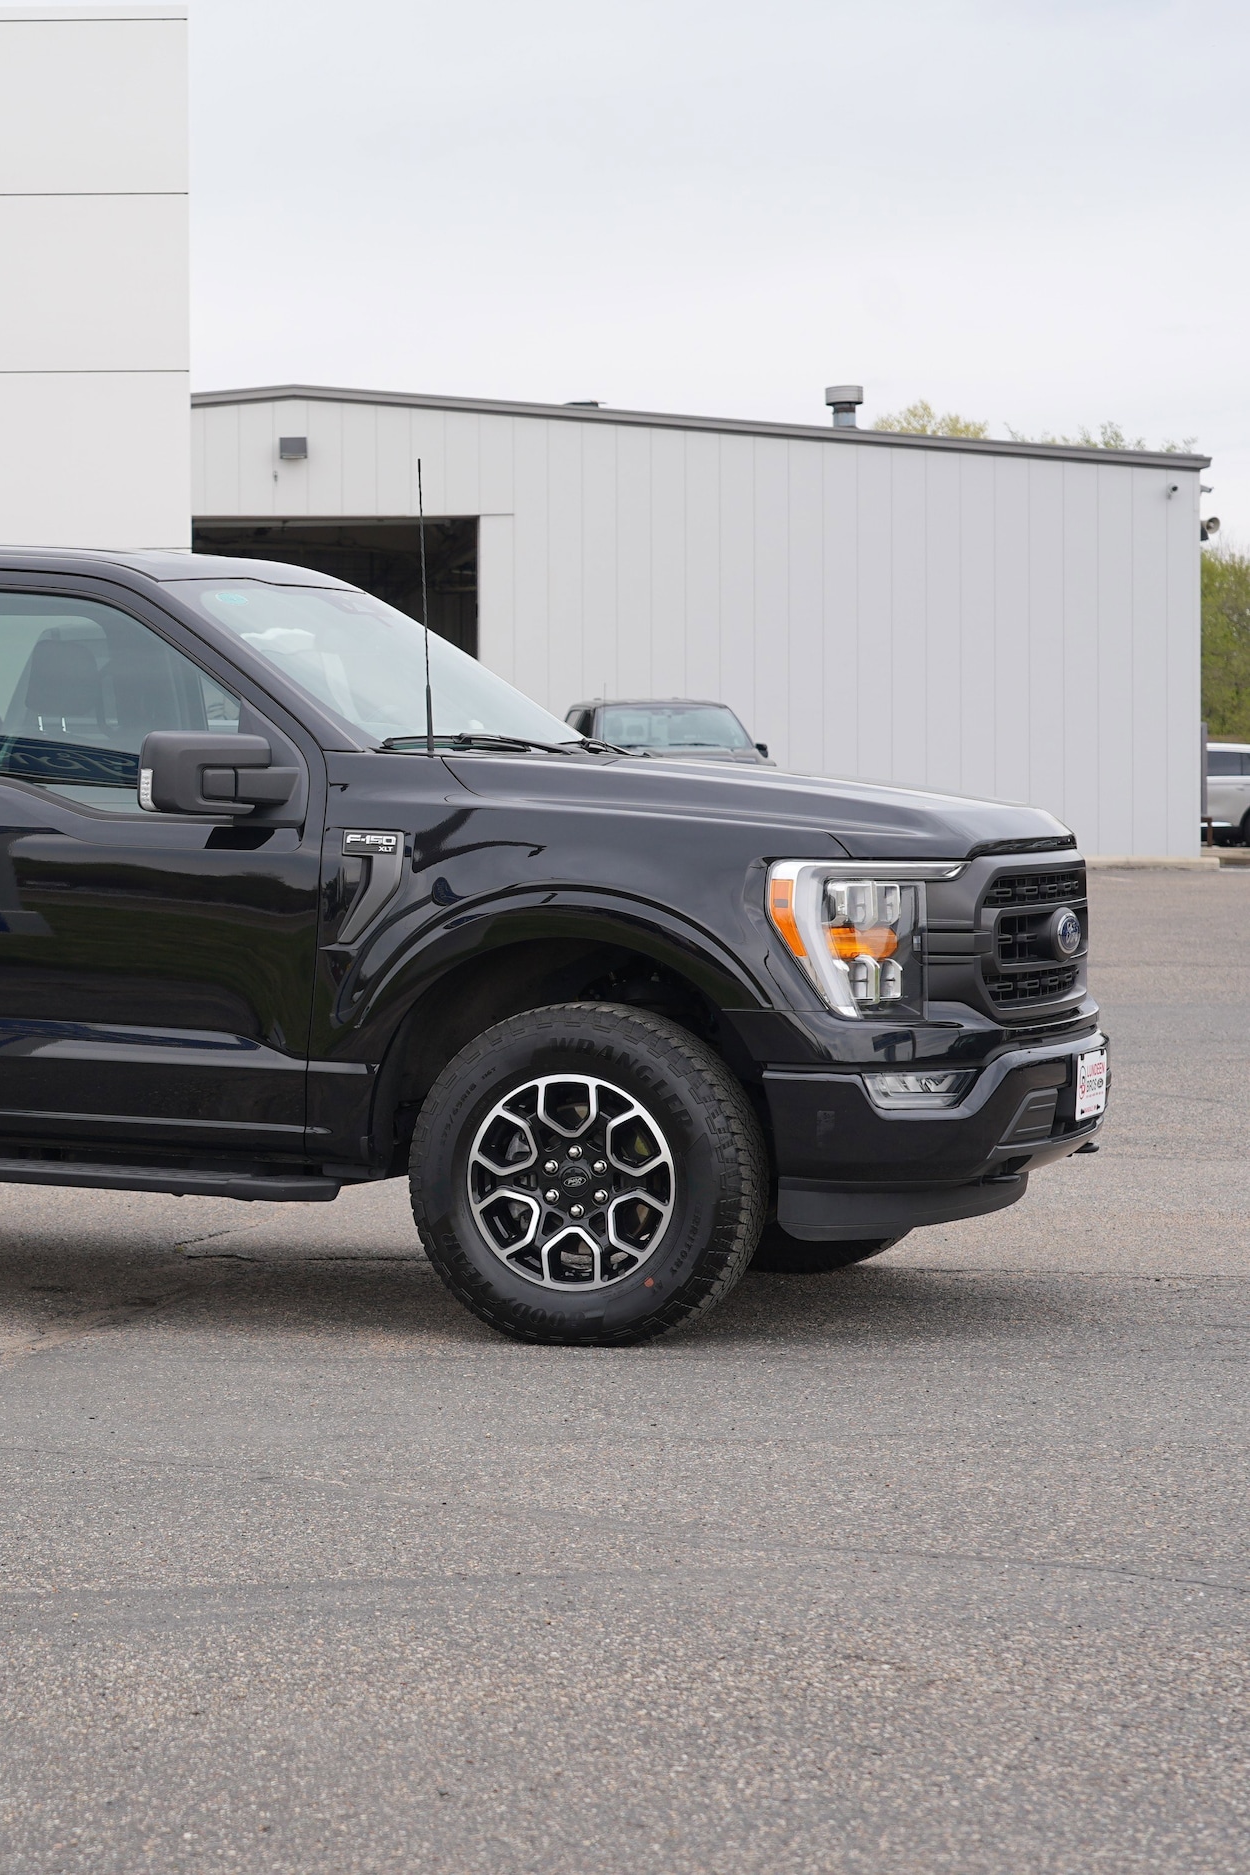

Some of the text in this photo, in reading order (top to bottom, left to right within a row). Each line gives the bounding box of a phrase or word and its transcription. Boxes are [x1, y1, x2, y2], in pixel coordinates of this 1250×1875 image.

[346, 834, 397, 846] F-150
[1086, 1062, 1106, 1078] LUNDEEN
[549, 1037, 694, 1128] WRANGLER
